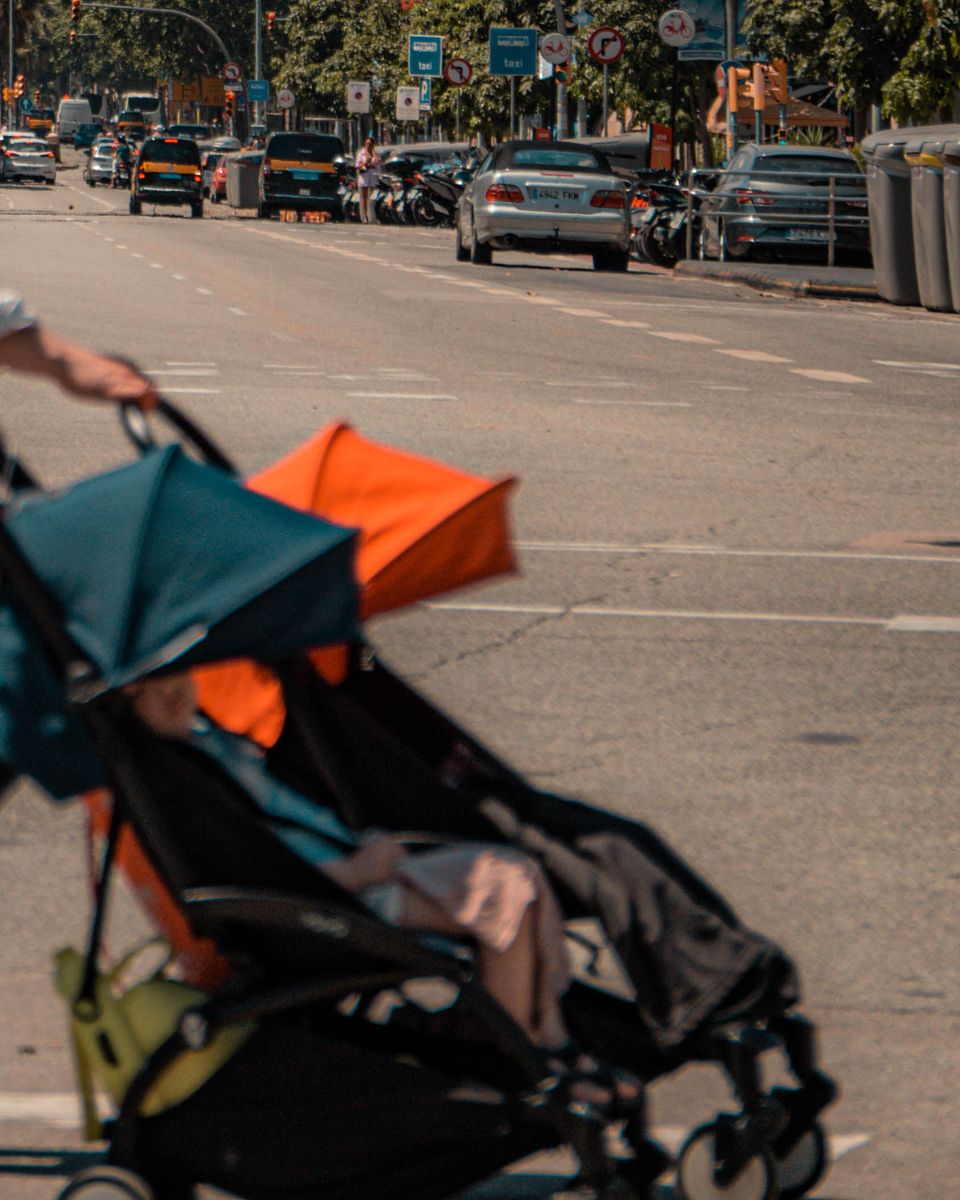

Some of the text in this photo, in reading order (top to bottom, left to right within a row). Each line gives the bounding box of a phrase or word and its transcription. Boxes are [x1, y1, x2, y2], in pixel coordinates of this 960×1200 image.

[418, 61, 433, 71] taxi
[503, 57, 524, 69] taxi
[421, 80, 428, 101] P
